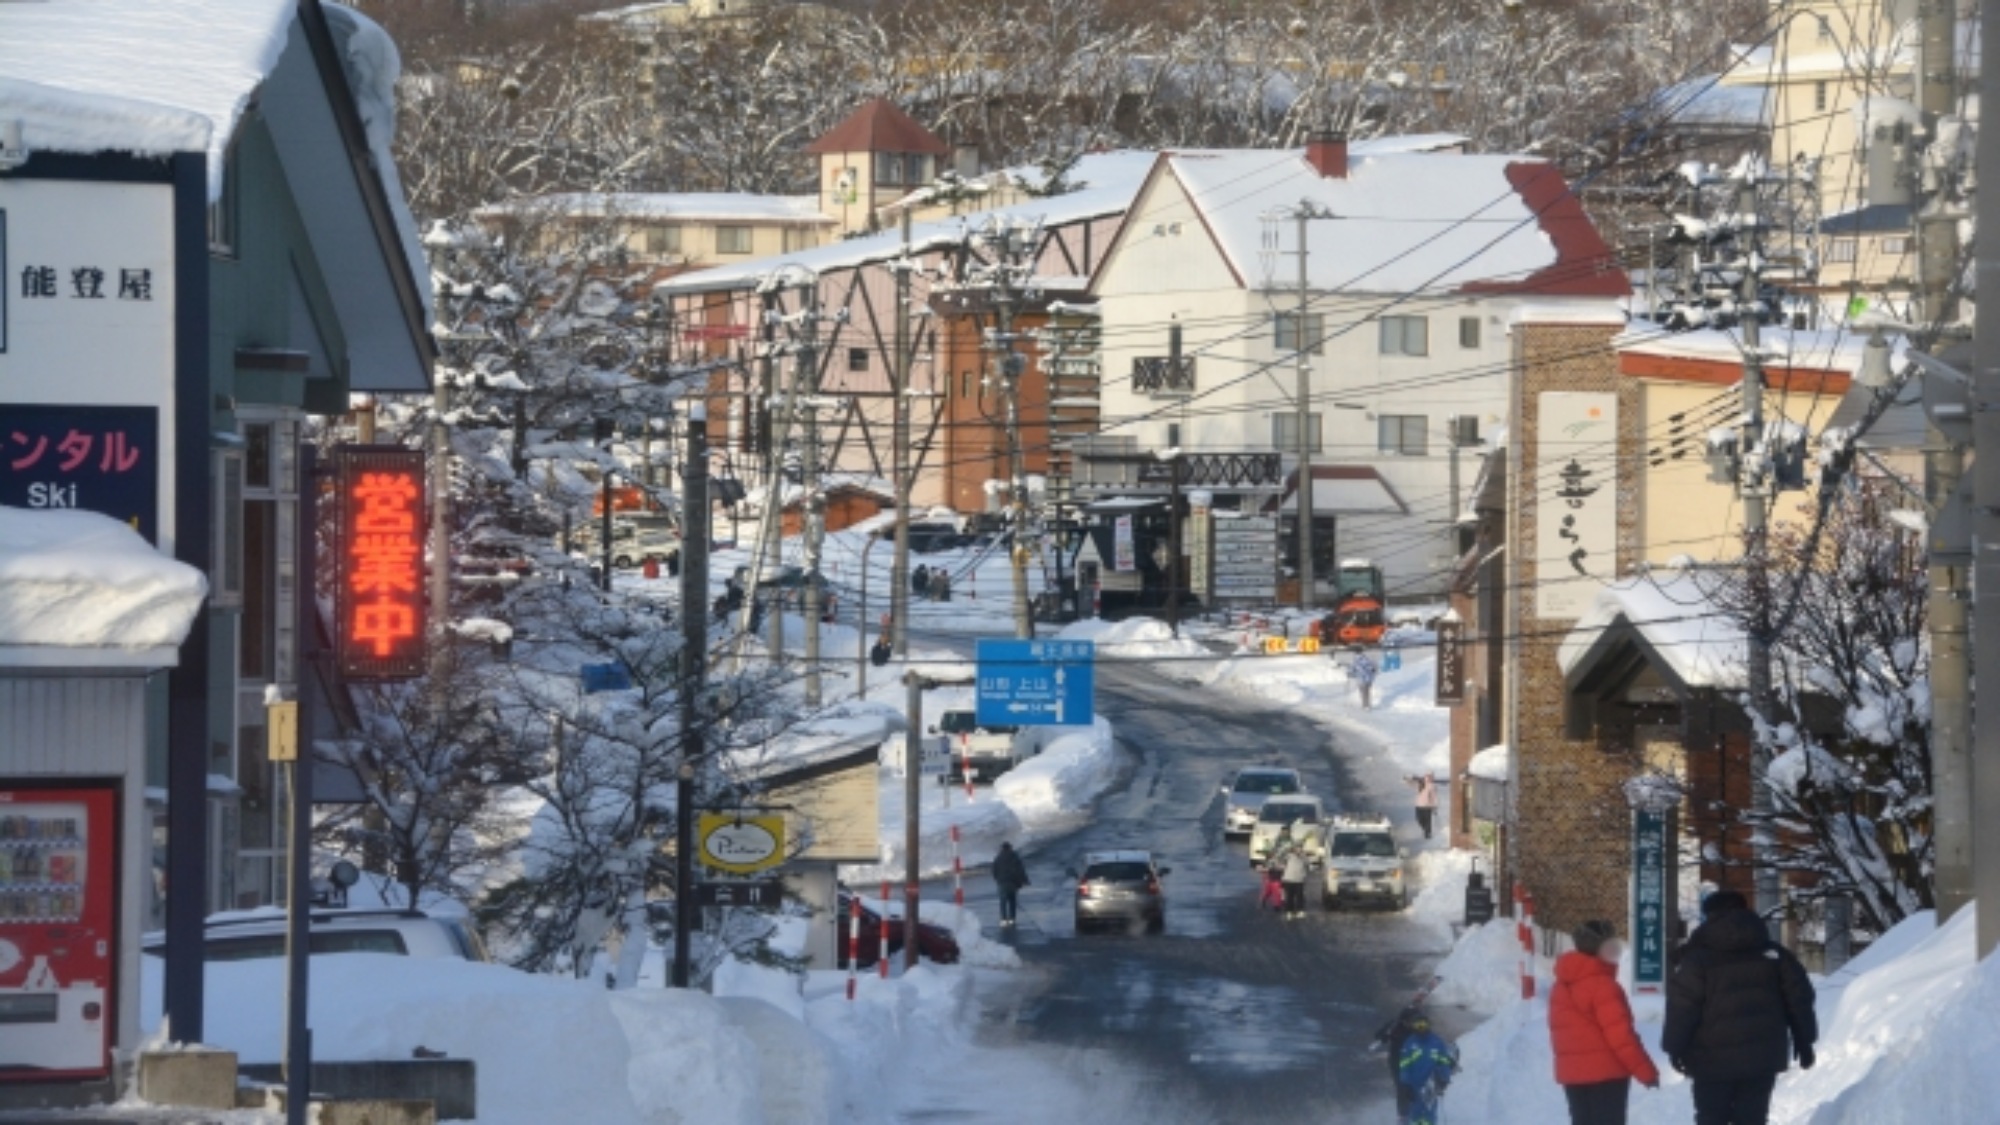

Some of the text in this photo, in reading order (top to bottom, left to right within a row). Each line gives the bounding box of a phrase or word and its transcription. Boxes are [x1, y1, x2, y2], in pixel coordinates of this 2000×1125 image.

[21, 265, 152, 300] 能登屋
[0, 431, 139, 472] ンタル
[27, 482, 77, 508] Ski
[351, 474, 418, 656] 営業中
